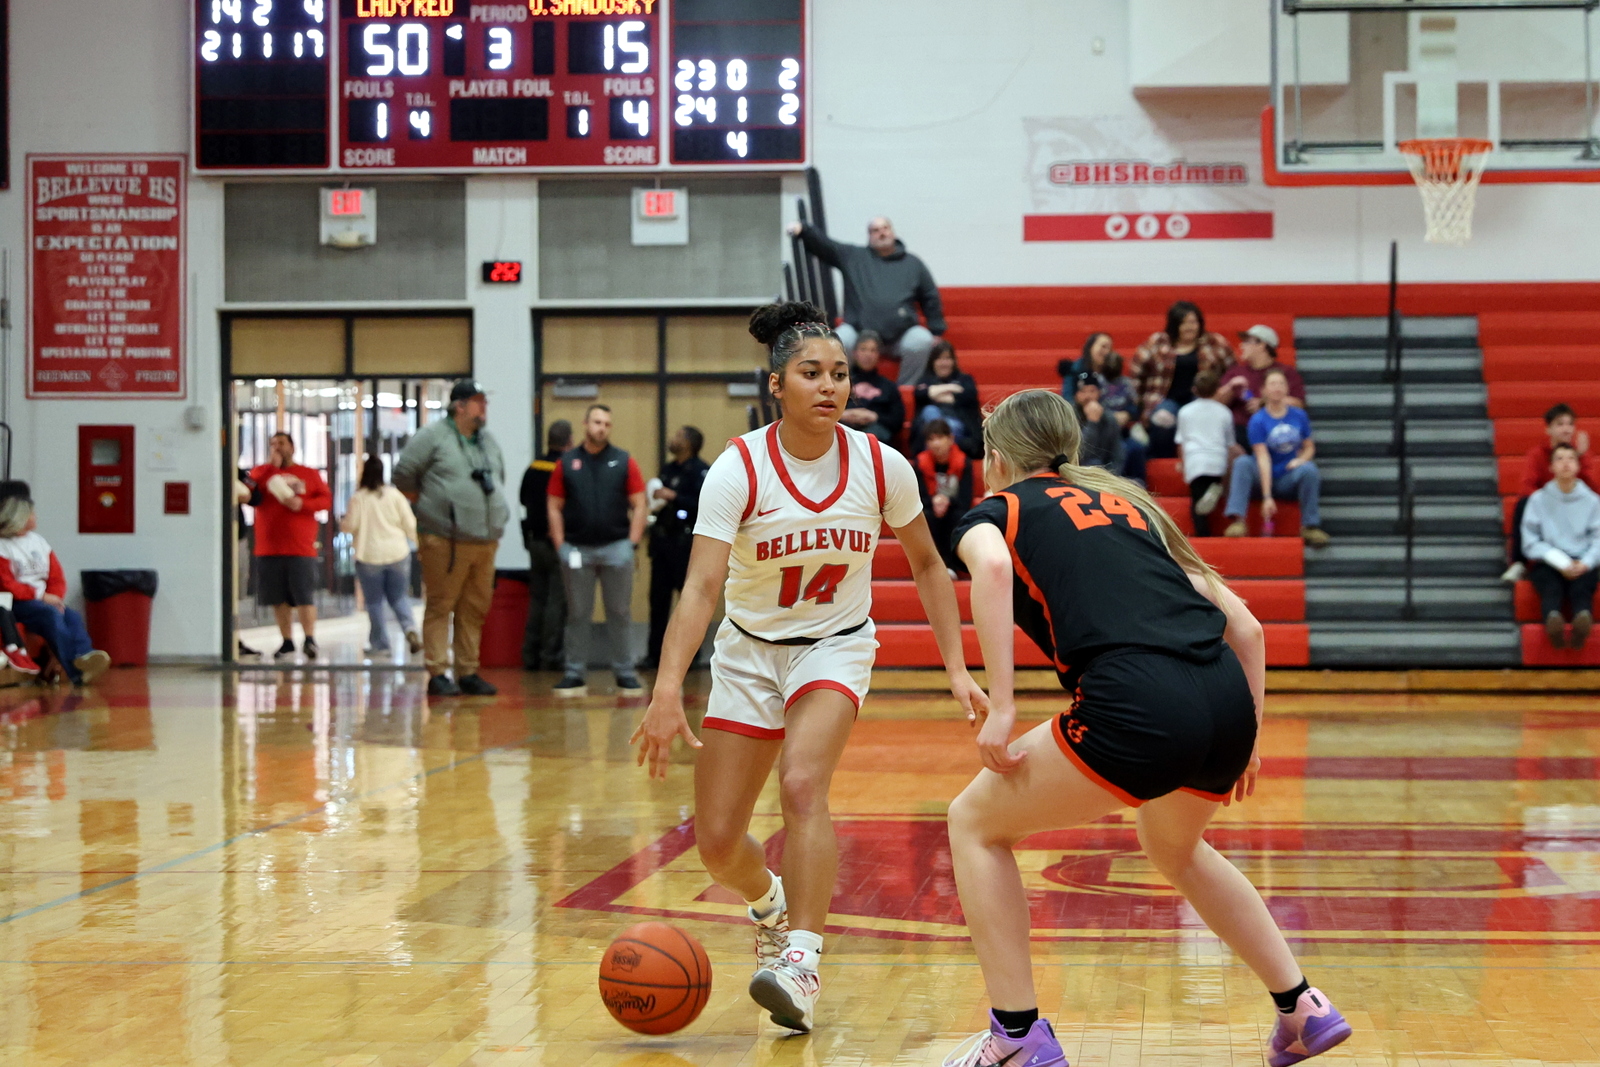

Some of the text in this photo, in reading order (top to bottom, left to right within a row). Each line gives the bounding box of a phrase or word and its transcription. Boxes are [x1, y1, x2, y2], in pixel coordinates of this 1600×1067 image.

[212, 0, 324, 26] 14 2 4
[470, 5, 527, 22] PERIOD
[201, 29, 324, 62] 21 1 17
[364, 24, 429, 75] 50
[489, 27, 512, 69] 3
[603, 21, 649, 73] 15
[604, 78, 655, 96] FOULS
[674, 58, 800, 91] 23 0 2
[344, 80, 394, 98] FOULS
[449, 79, 553, 97] PLAYER FOUL
[376, 103, 388, 138] 1
[578, 109, 589, 135] 1
[622, 100, 649, 136] 4
[674, 93, 800, 126] 24 1 2
[409, 110, 430, 137] 4
[344, 148, 395, 166] SCORE
[473, 148, 527, 165] MATCH
[604, 146, 656, 163] SCORE
[726, 131, 748, 158] 4
[66, 163, 148, 175] WELCOME TO
[1049, 160, 1248, 186] @BHSRedmen
[36, 176, 177, 205] BELLEVUE HS
[332, 190, 362, 215] EXIT
[645, 191, 674, 216] EXIT
[36, 207, 178, 221] SPORTSMANSHIP
[36, 236, 177, 250] EXPECTATION
[67, 276, 147, 287] PLAYERS PLAY
[1044, 486, 1148, 531] 24
[756, 528, 872, 561] BELLEVUE
[778, 563, 849, 609] 14
